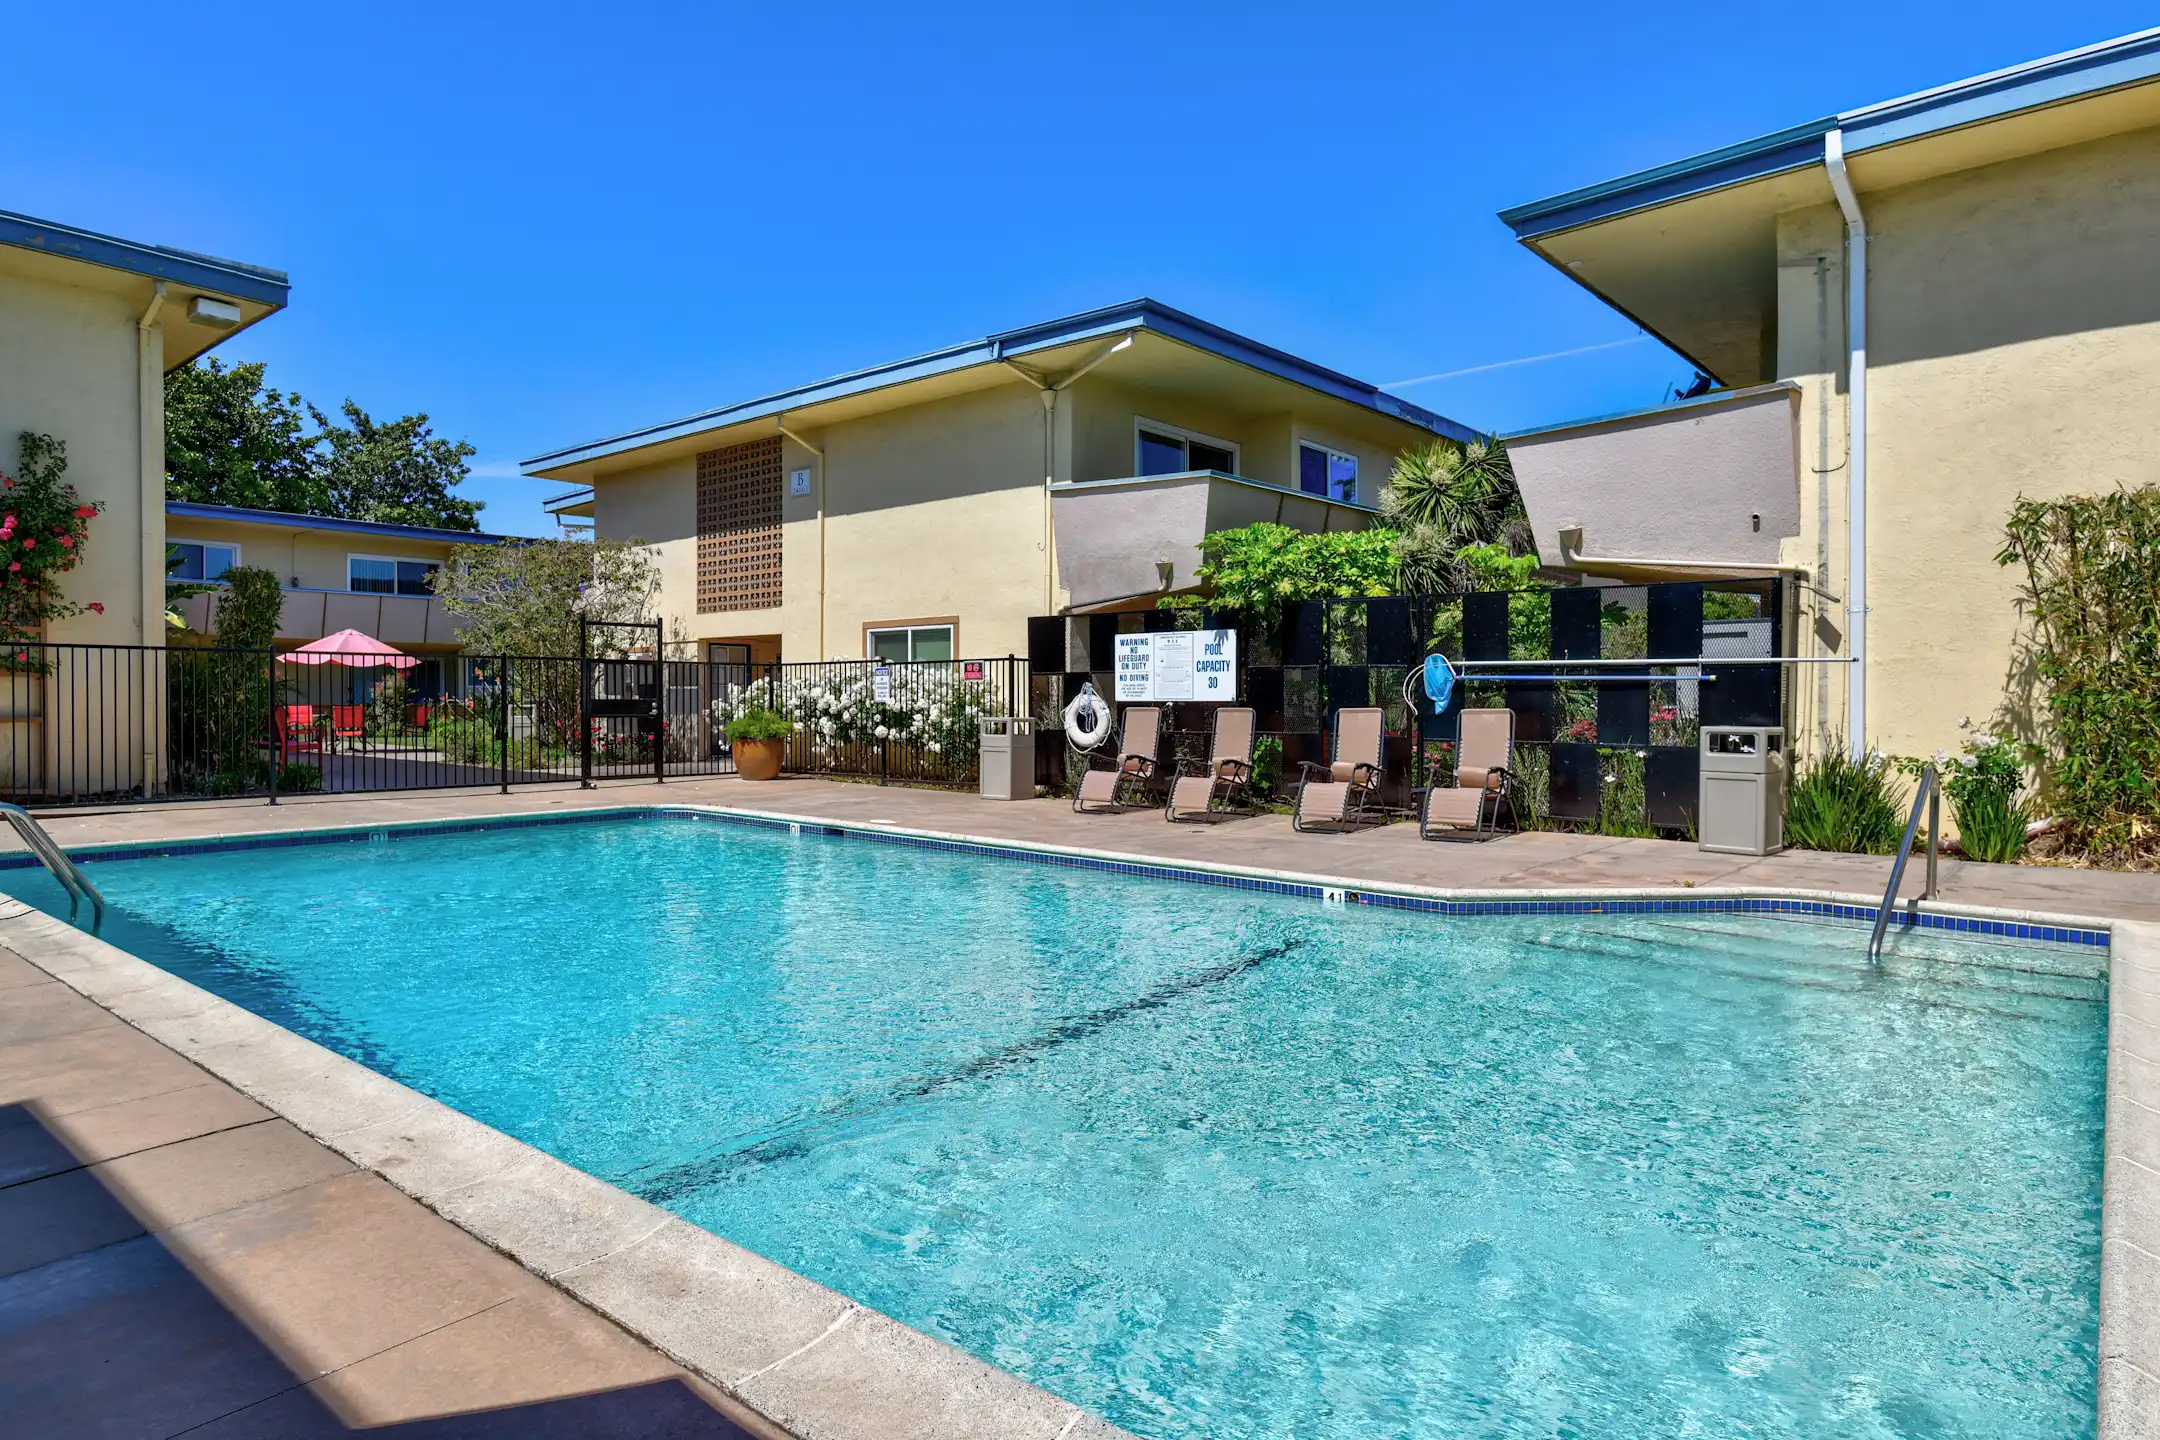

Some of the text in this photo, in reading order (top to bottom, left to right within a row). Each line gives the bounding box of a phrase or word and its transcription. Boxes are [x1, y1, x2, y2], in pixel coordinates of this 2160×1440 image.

[798, 472, 804, 486] B
[1120, 638, 1148, 646] WARNING
[1130, 646, 1138, 654] NO
[1204, 643, 1223, 656] POOL
[1118, 654, 1150, 662] LIFEGUARD
[1121, 662, 1147, 670] ON DUTY
[1196, 660, 1231, 673] CAPACITY
[1208, 676, 1218, 689] 30
